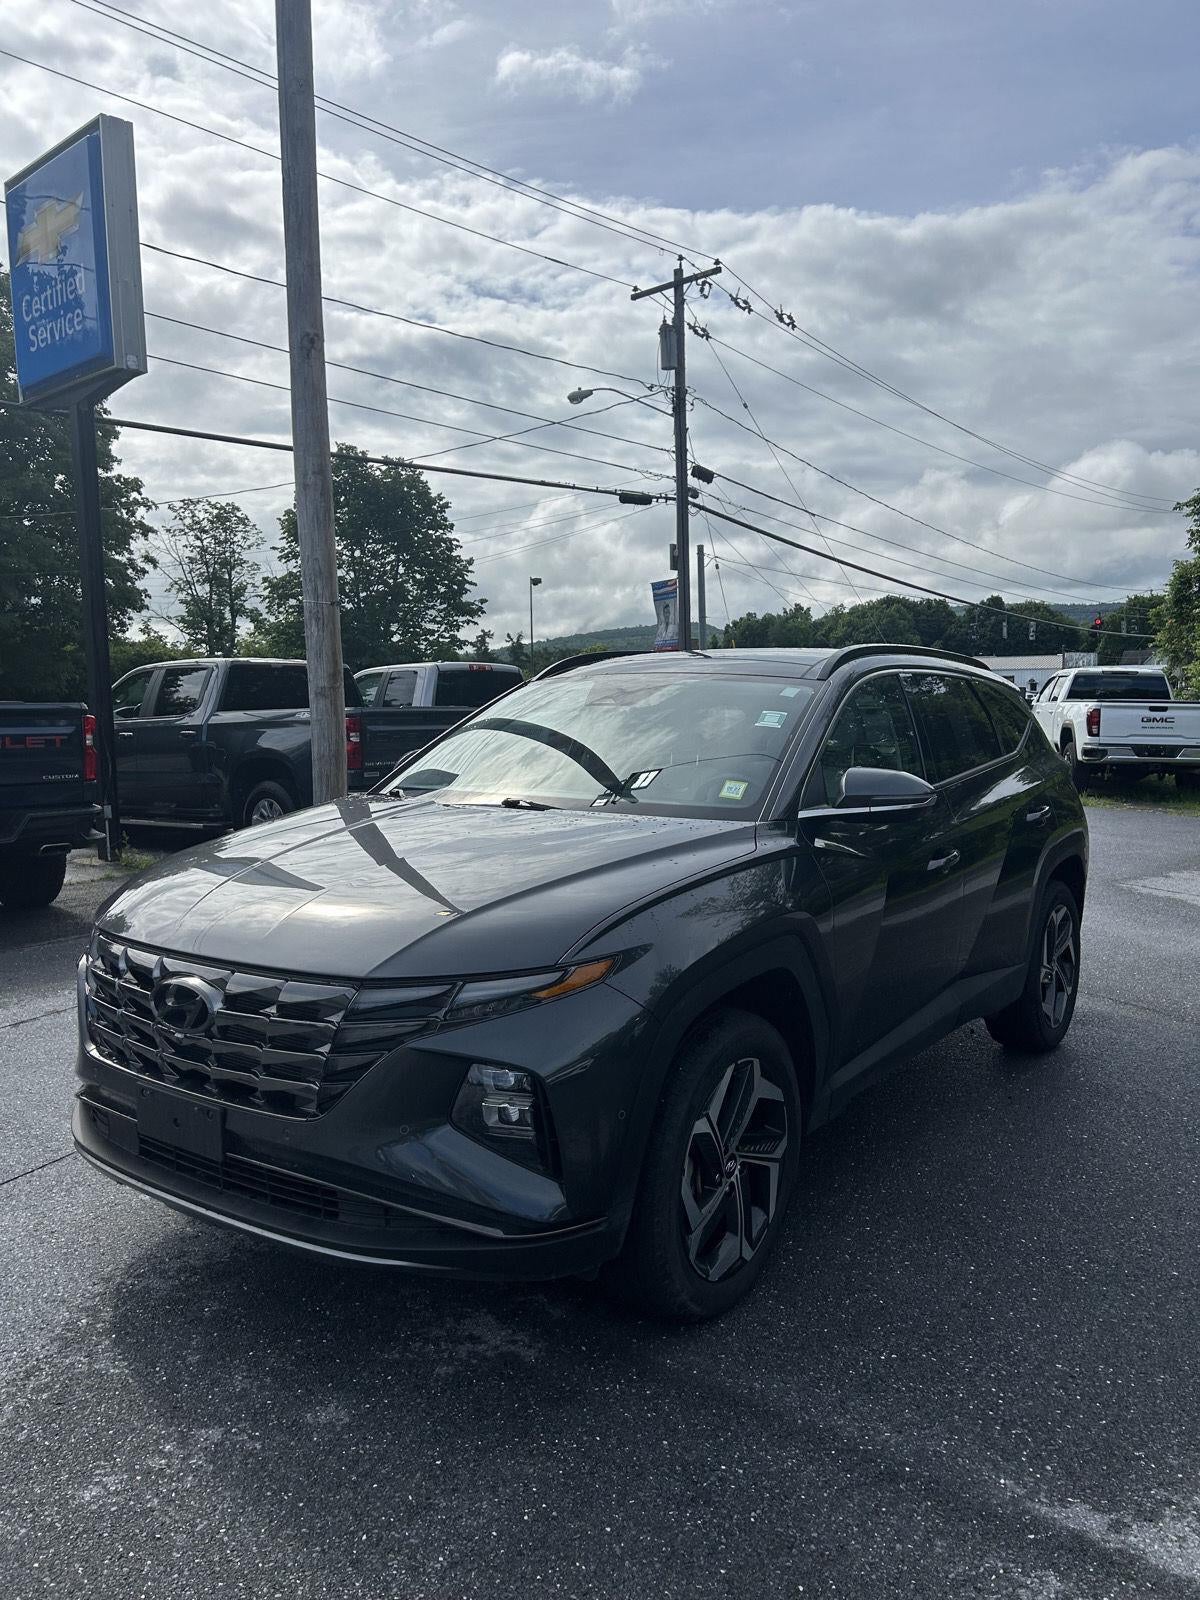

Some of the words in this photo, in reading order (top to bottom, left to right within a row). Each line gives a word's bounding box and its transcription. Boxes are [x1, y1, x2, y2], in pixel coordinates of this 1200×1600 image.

[22, 264, 85, 322] Certified
[28, 310, 83, 352] Service
[0, 735, 68, 749] LET
